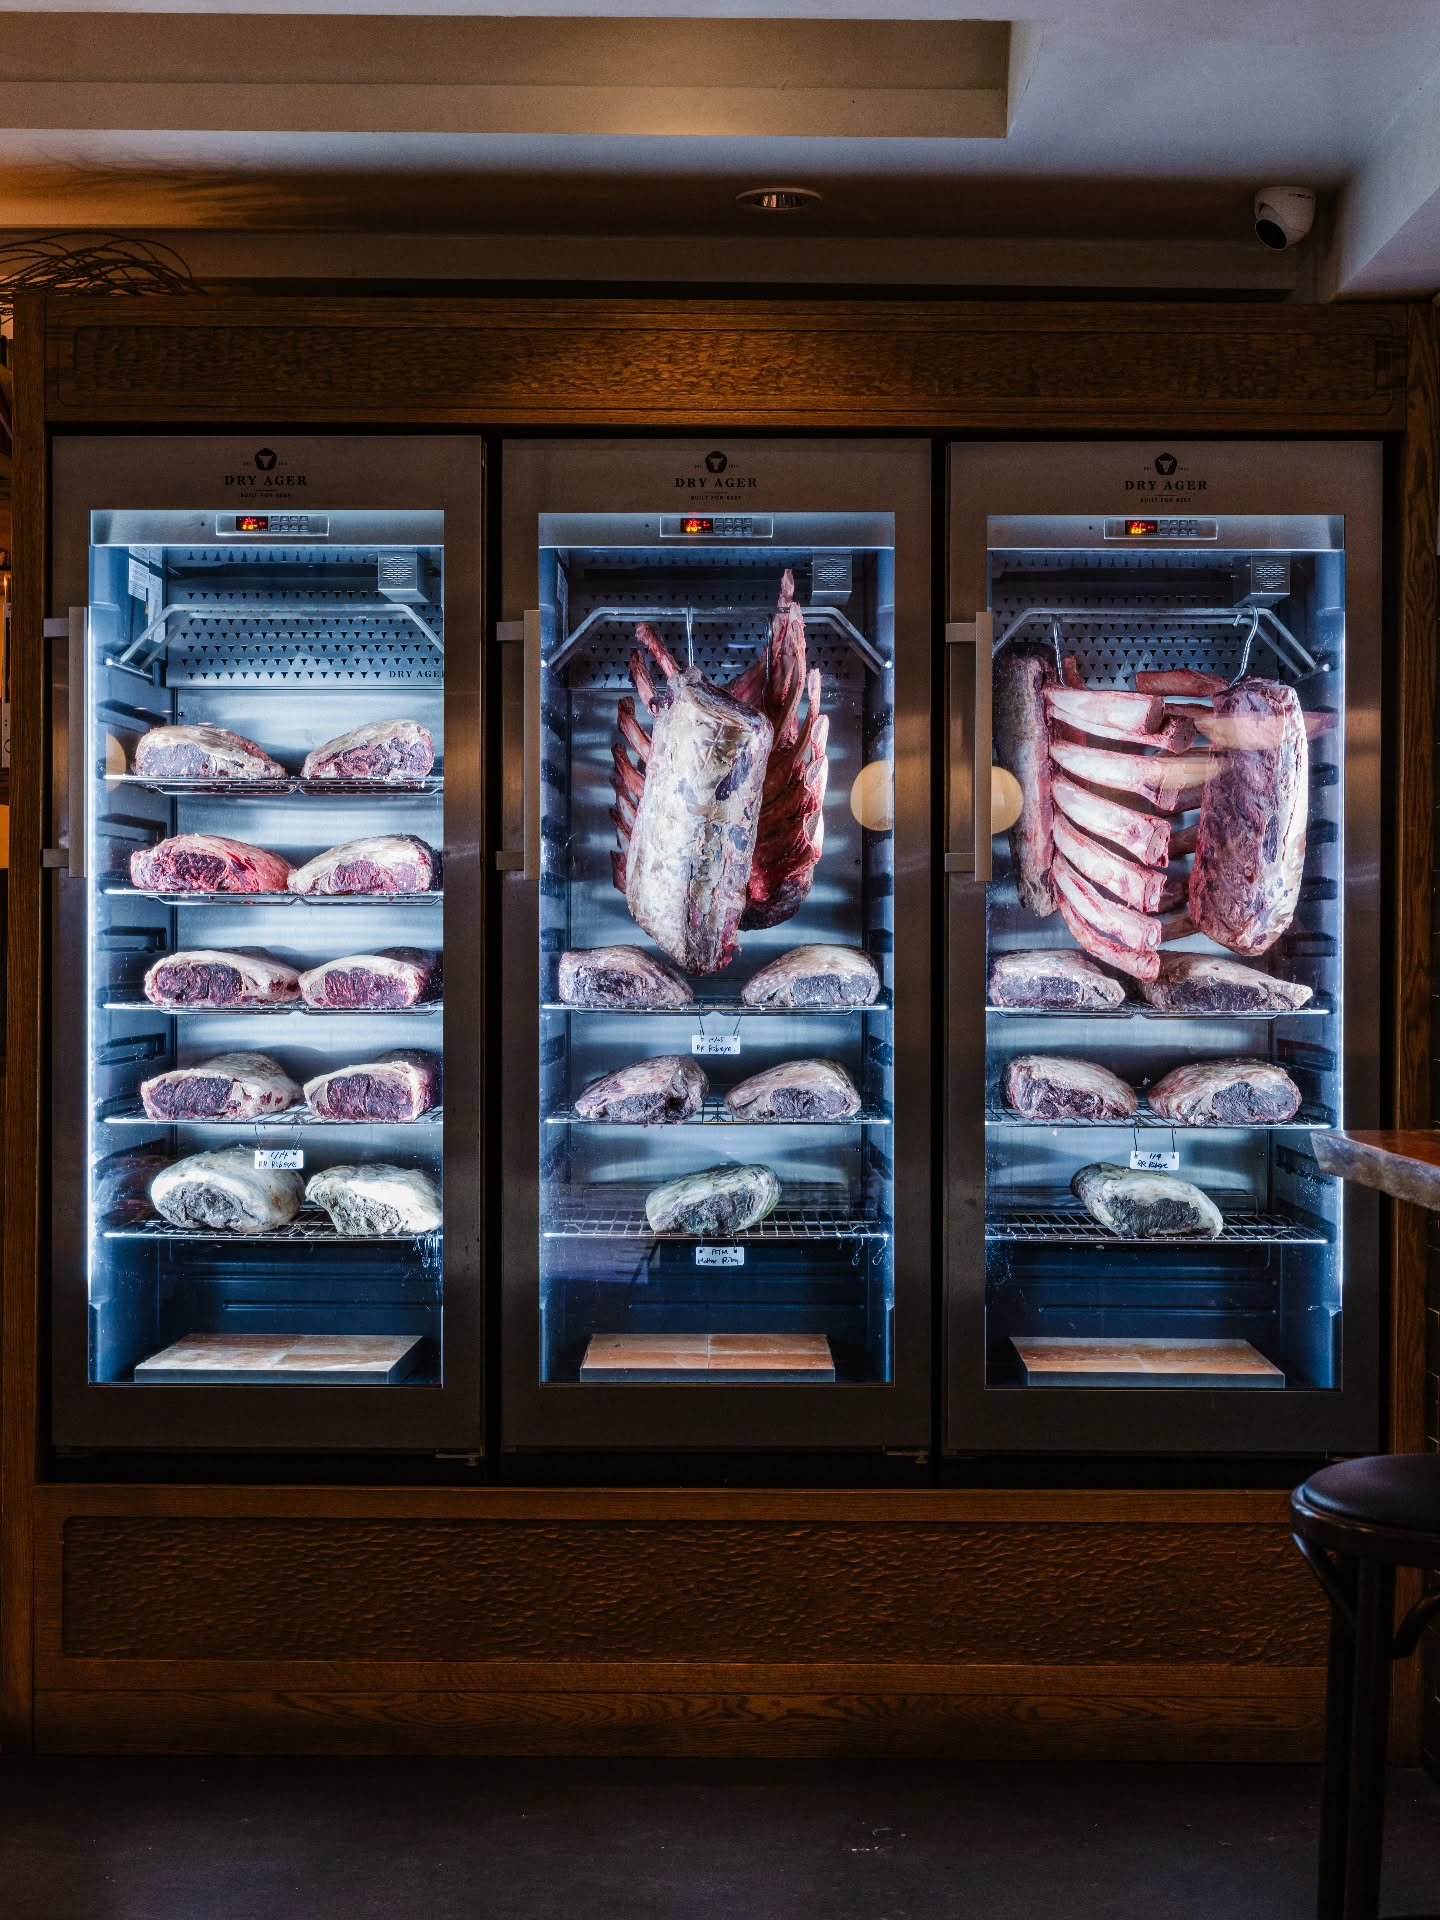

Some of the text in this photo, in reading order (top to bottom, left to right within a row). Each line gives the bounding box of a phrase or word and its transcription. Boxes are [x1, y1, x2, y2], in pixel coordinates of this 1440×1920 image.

[224, 475, 307, 486] DRY AGER
[675, 477, 757, 488] DRY AGER
[1124, 480, 1207, 490] DRY AGER
[389, 670, 412, 678] DRY
